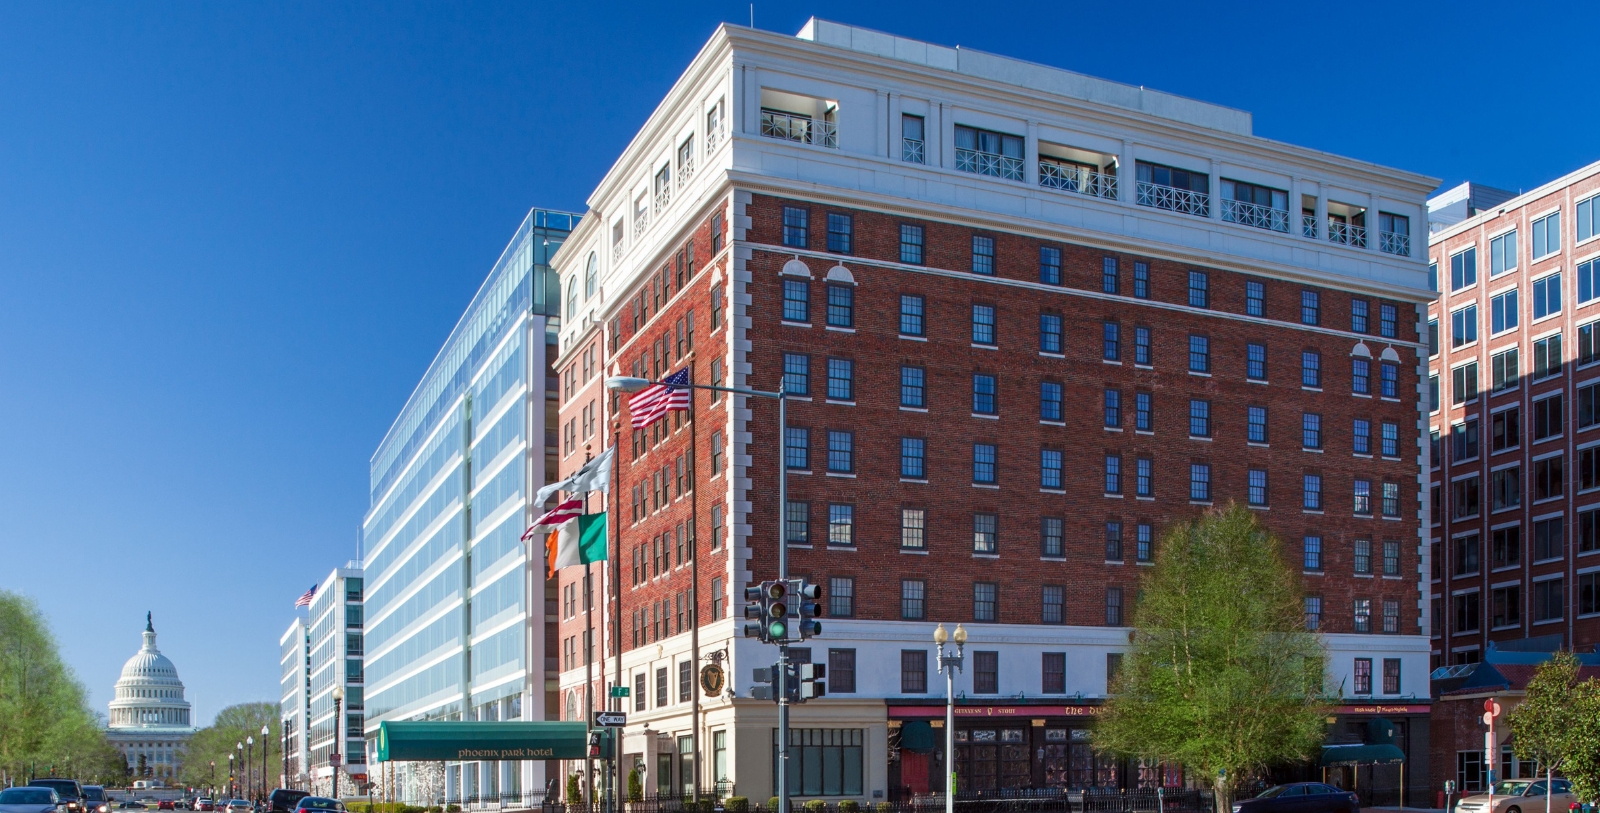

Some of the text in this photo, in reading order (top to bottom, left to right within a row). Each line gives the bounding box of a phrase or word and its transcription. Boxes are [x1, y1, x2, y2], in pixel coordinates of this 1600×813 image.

[1065, 706, 1083, 715] the
[458, 747, 554, 759] phoenix park hotel
